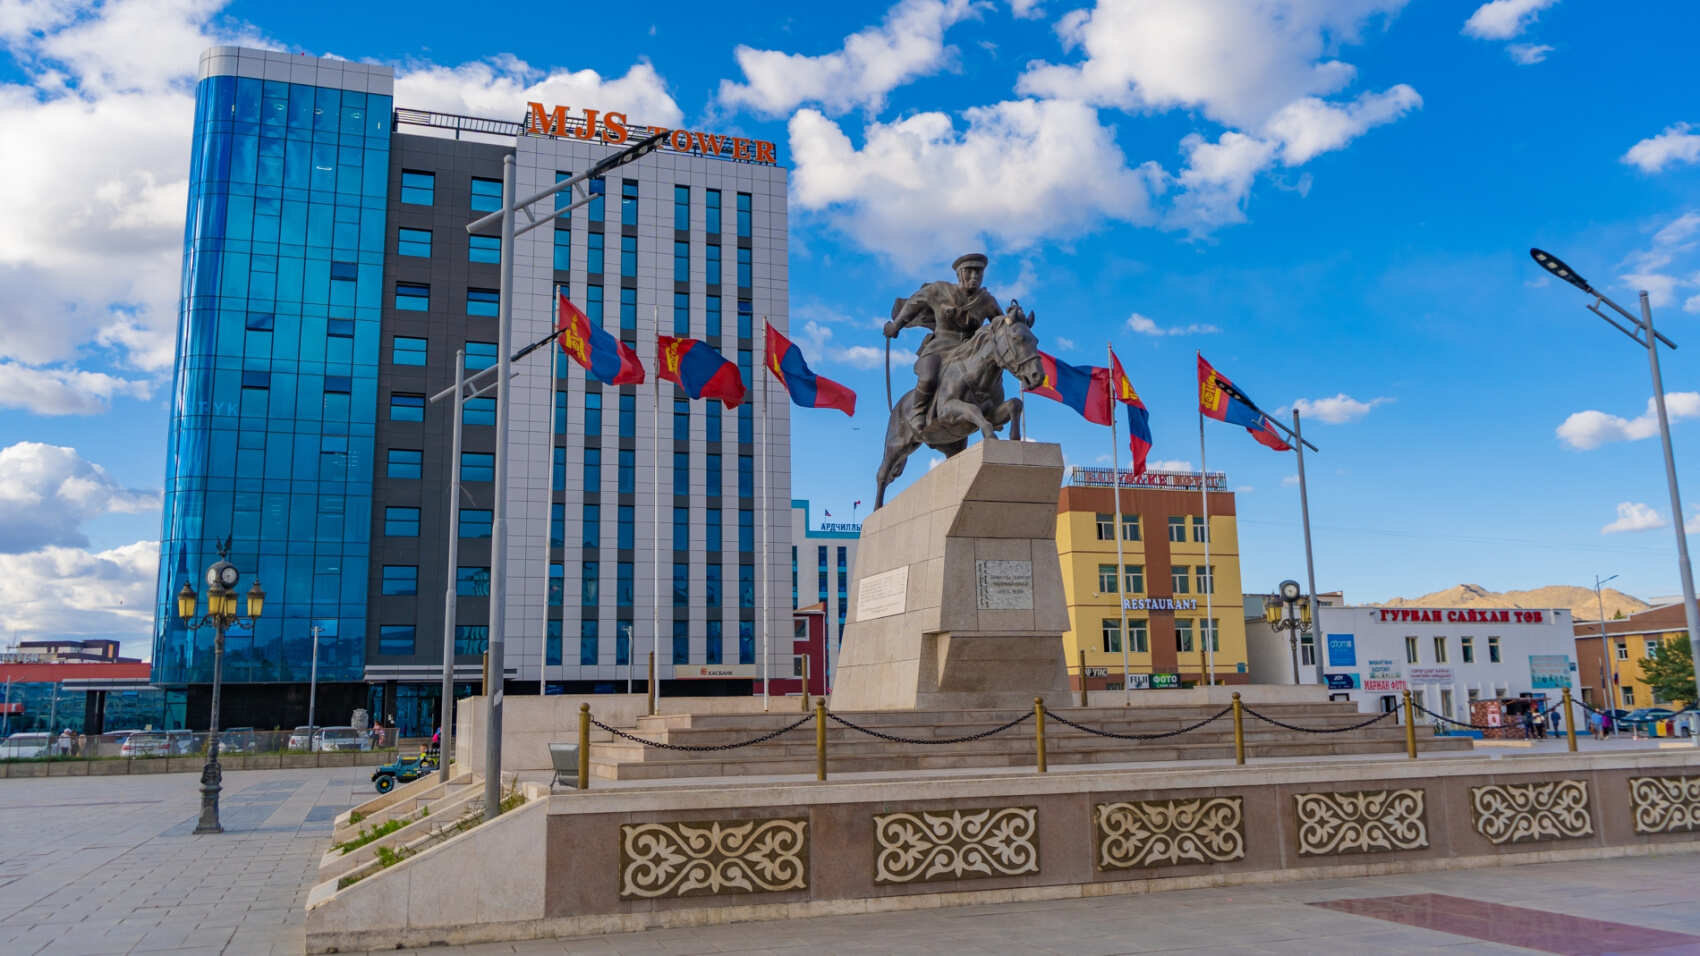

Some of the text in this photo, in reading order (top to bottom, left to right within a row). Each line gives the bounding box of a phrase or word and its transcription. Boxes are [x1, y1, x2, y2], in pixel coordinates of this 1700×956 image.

[527, 101, 628, 145] MJS
[1123, 598, 1197, 610] RESTAURANT
[1380, 608, 1543, 624] ГУРВАН САЙХАН ТӨВ
